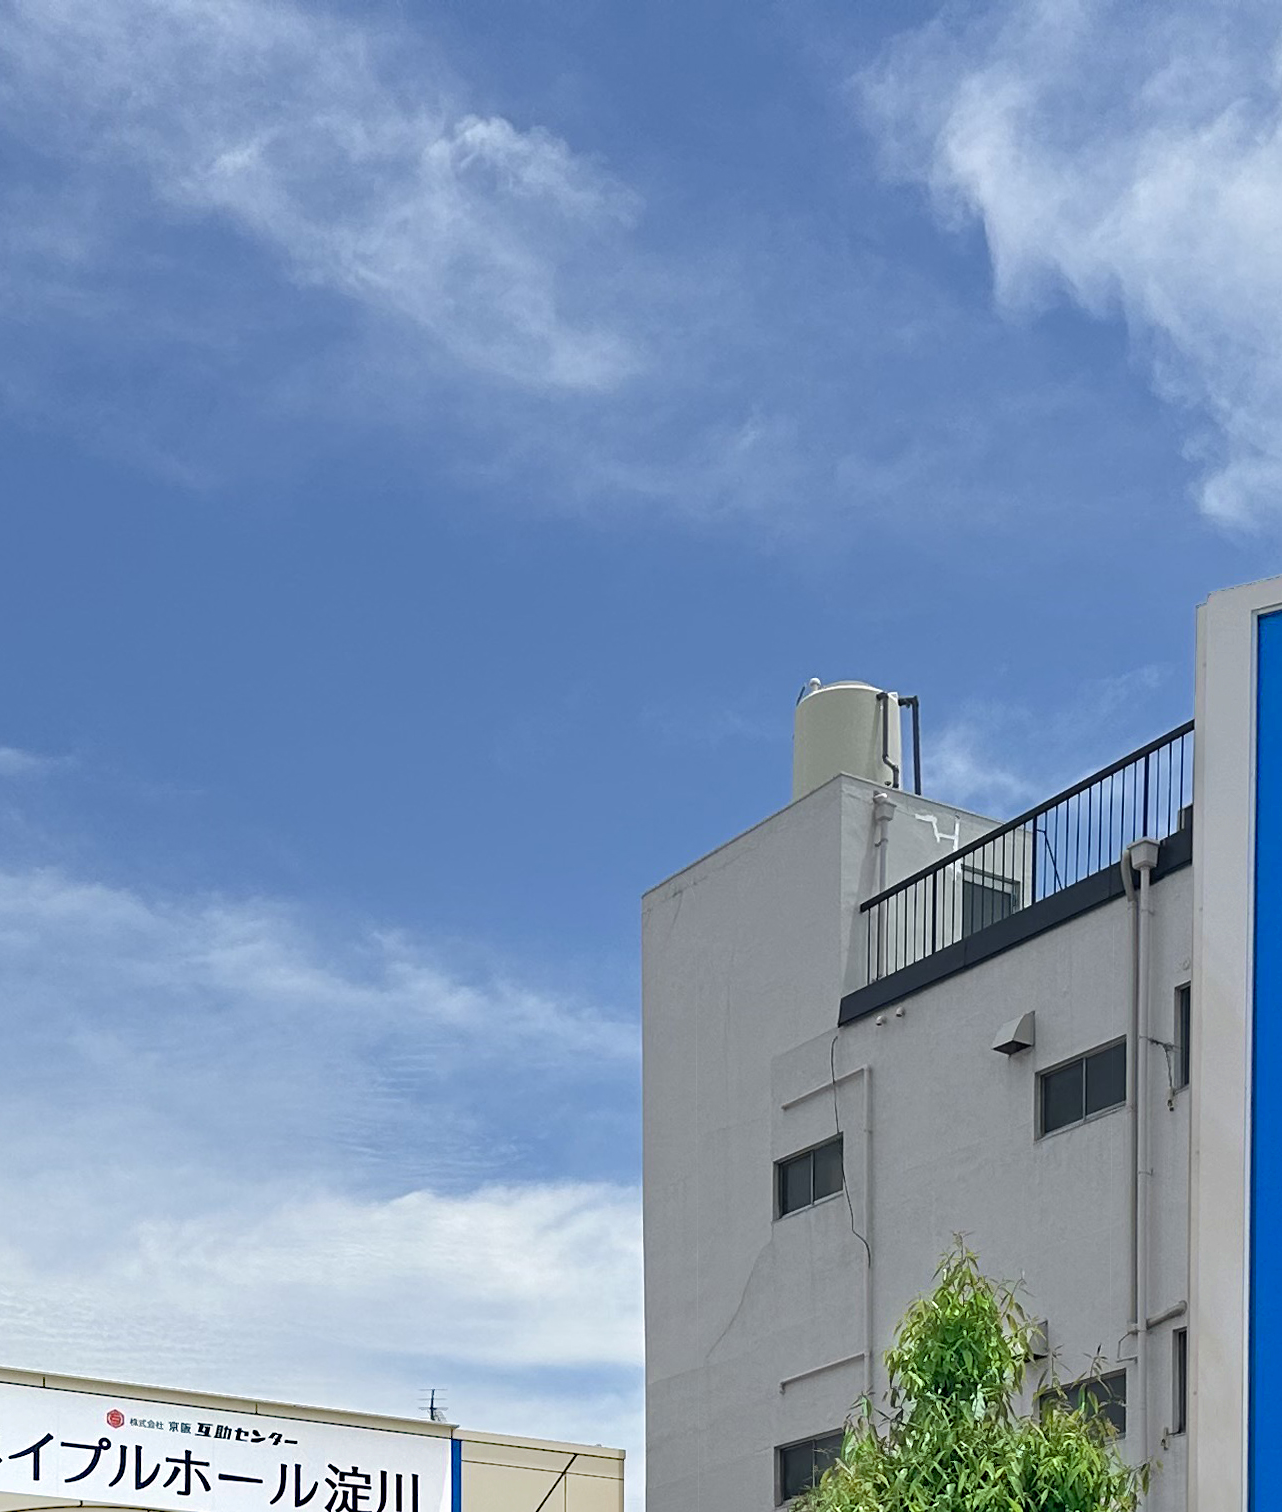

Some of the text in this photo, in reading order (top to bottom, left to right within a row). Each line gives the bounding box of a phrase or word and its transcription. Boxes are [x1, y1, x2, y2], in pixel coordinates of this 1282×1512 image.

[129, 1417, 299, 1446] 株式会社 京阪 互助センター
